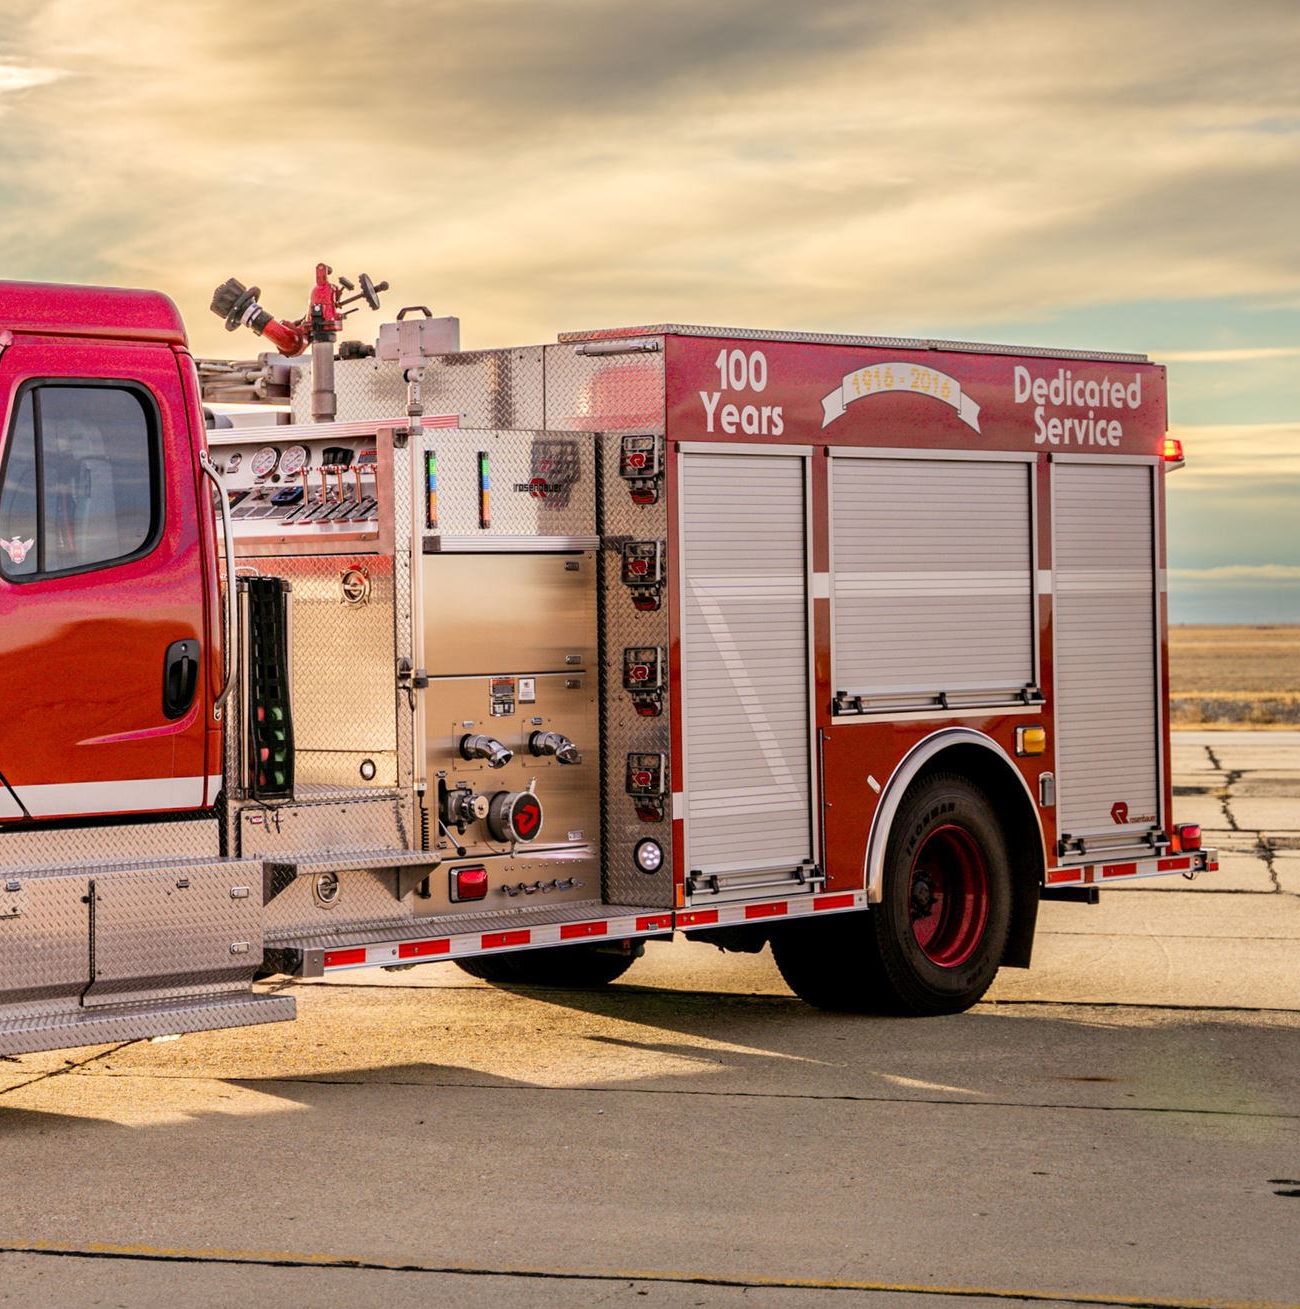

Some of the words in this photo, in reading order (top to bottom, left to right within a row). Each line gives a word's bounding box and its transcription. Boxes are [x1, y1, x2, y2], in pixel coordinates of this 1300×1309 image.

[714, 348, 768, 392] 100
[852, 366, 894, 395] 1916
[910, 367, 952, 401] 2016
[1014, 365, 1142, 409] Dedicated
[699, 391, 784, 436] Years
[1034, 406, 1123, 447] Service
[514, 482, 562, 493] rosenbauer
[906, 801, 956, 858] IRONMAN
